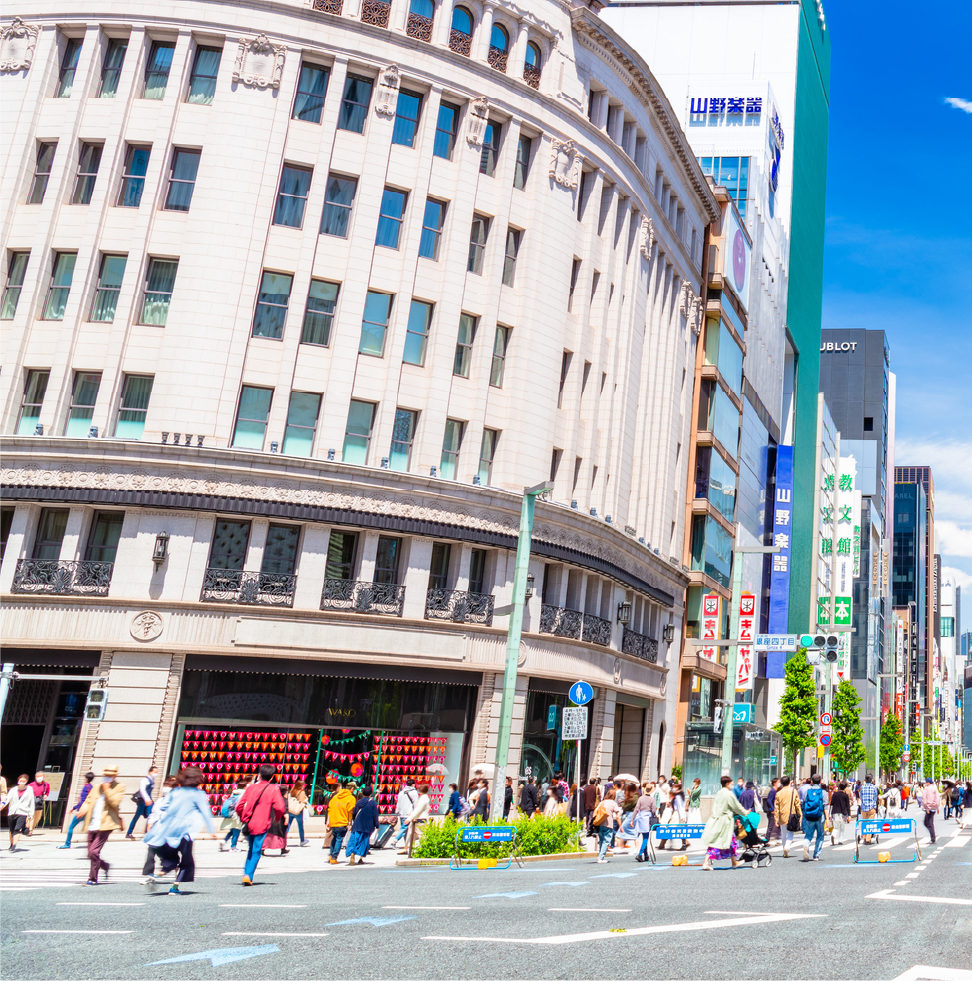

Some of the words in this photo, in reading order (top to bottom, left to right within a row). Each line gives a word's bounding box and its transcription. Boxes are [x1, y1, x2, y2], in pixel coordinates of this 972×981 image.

[690, 97, 763, 114] 山野楽器
[819, 342, 858, 352] UBLOT
[837, 473, 853, 554] 教文館
[773, 488, 791, 572] 山野楽器
[835, 600, 850, 620] 本
[756, 637, 795, 646] 銀座四丁目
[327, 707, 357, 717] WAKO
[325, 751, 371, 761] FUMIKO
